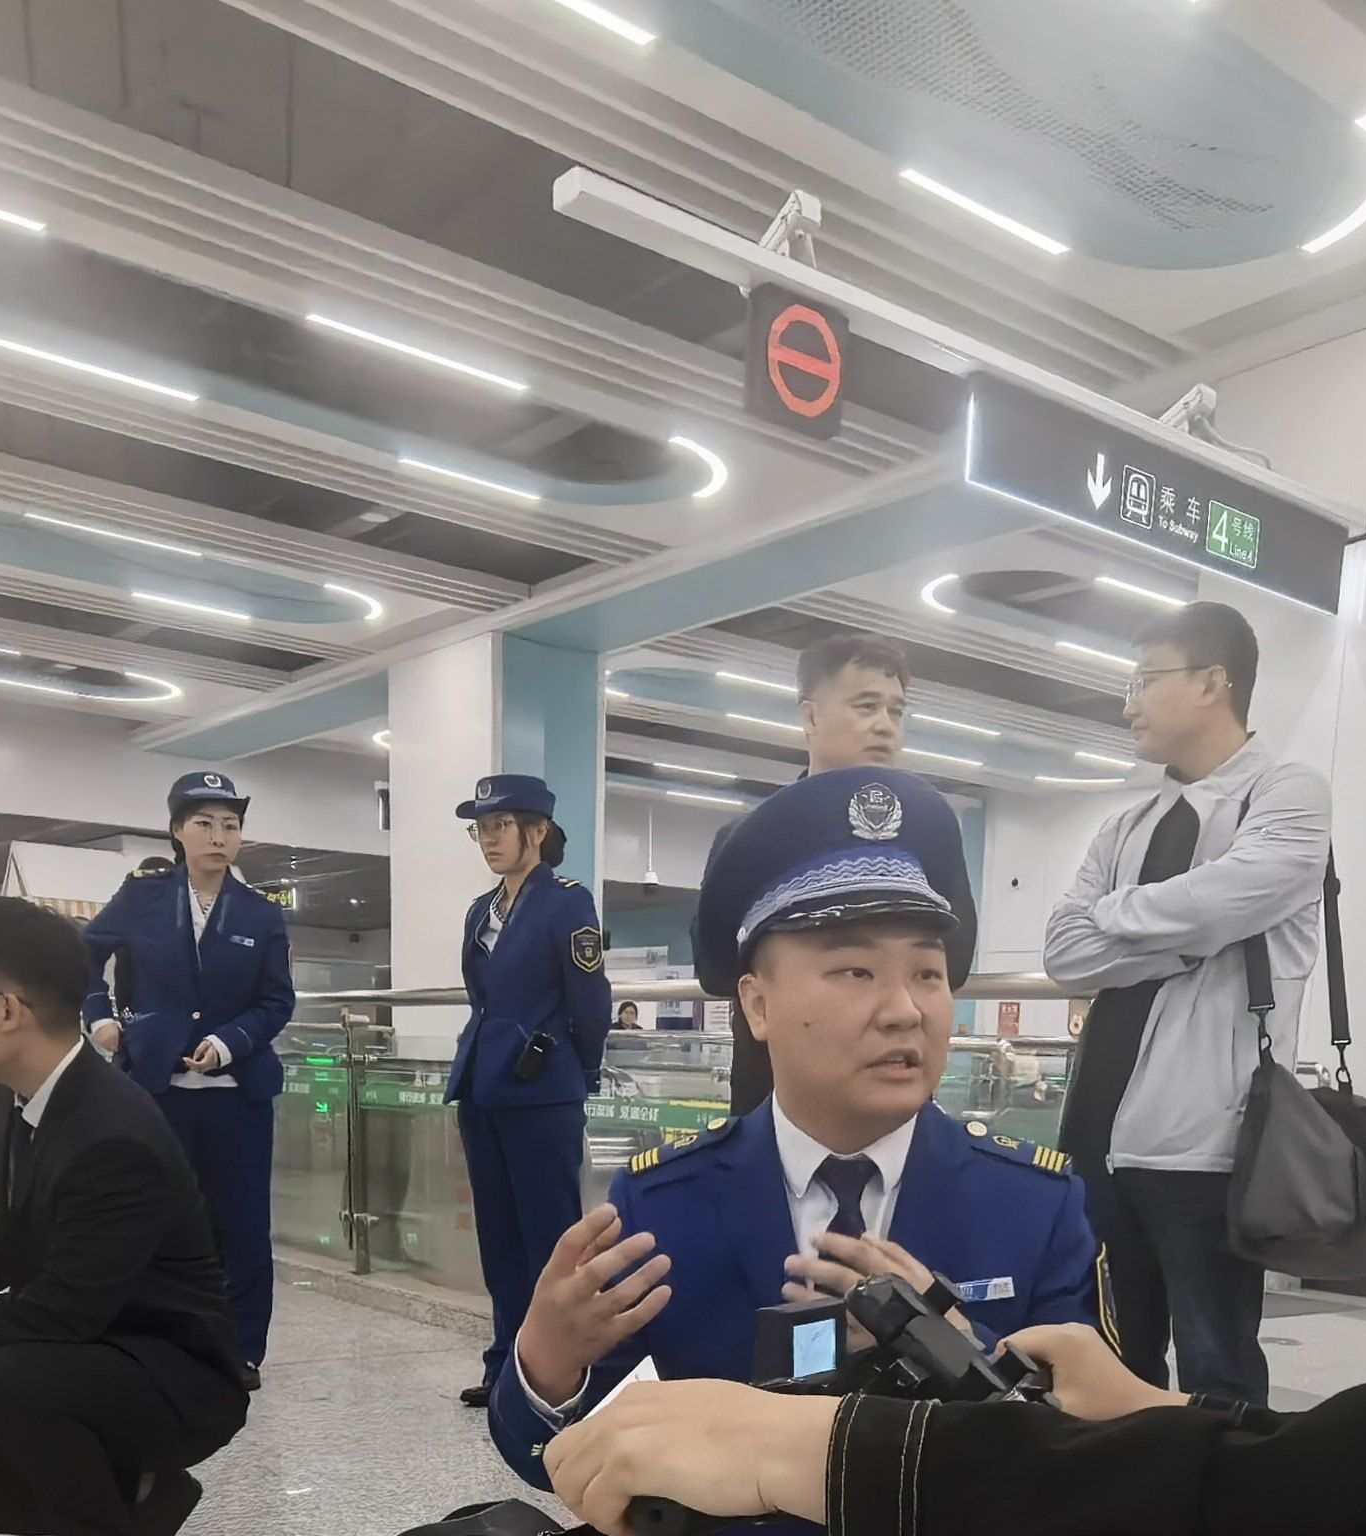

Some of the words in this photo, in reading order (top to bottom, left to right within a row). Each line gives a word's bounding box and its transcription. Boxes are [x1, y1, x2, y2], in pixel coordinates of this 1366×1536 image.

[1159, 485, 1202, 525] 乘车
[1158, 515, 1168, 530] To
[1168, 519, 1199, 544] Subway
